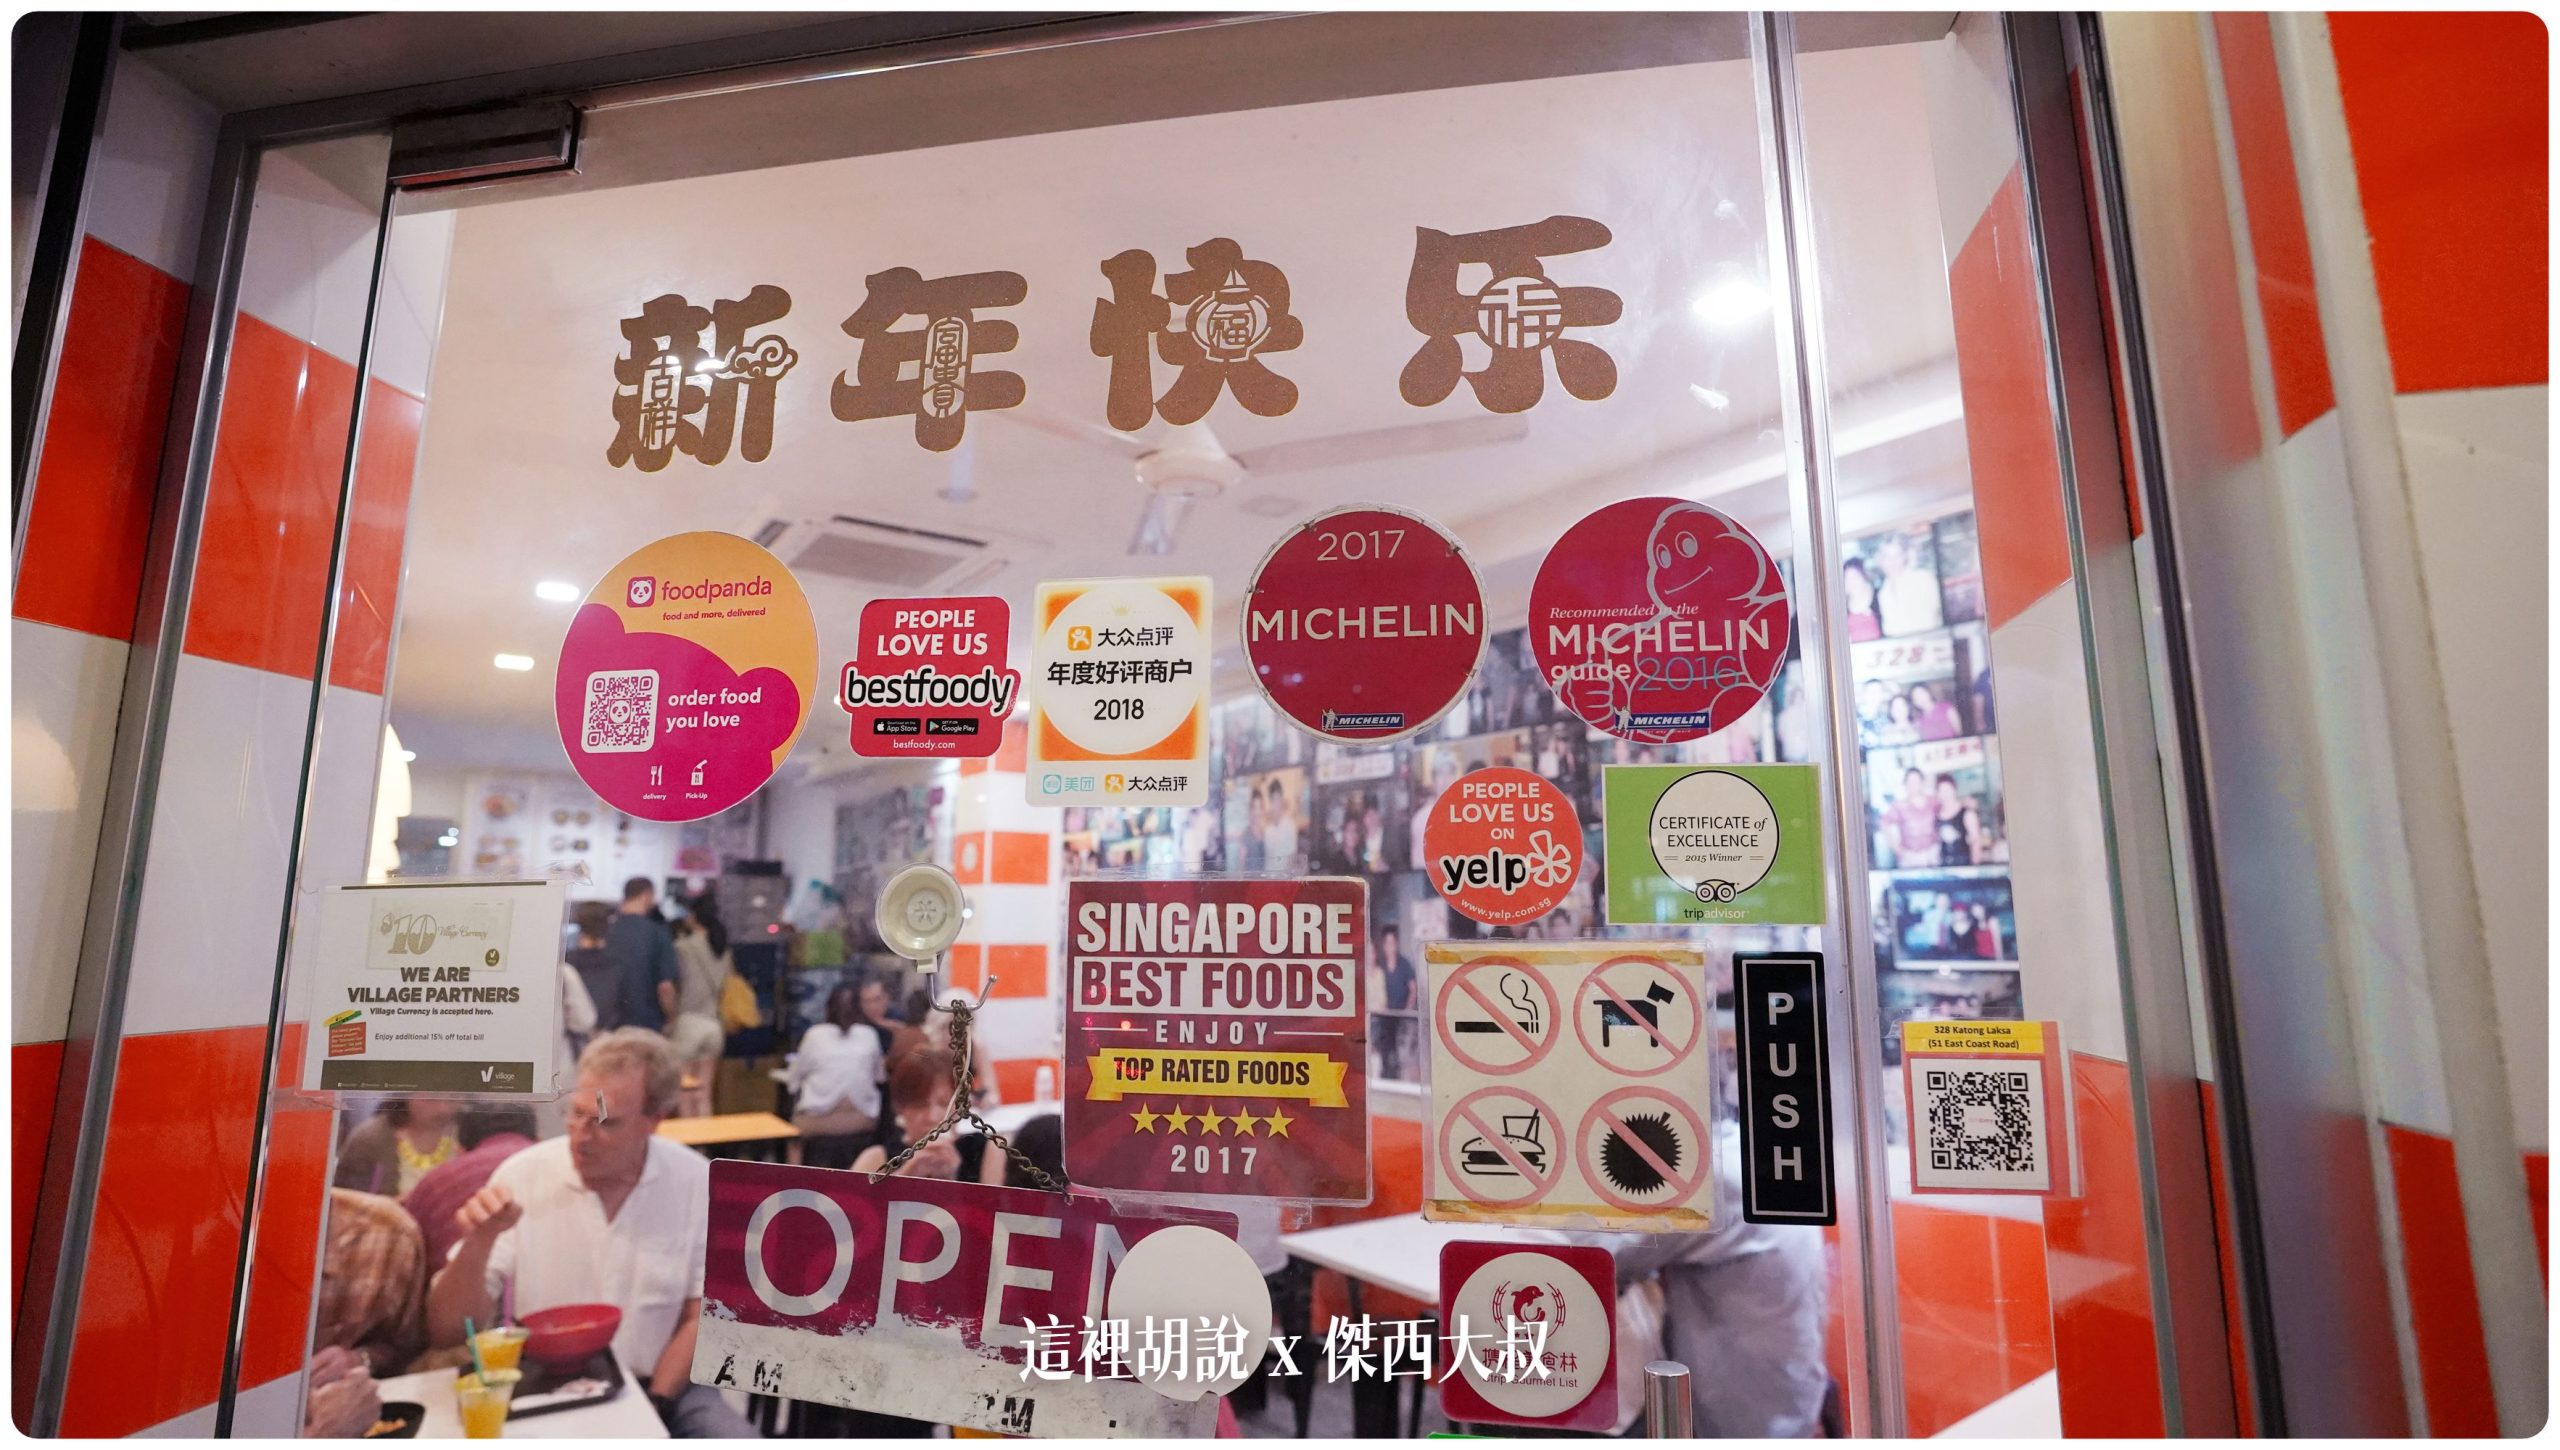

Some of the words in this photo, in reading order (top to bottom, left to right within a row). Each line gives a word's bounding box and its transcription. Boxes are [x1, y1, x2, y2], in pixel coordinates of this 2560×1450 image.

[1211, 306, 1252, 350] 福
[606, 215, 1624, 473] 新年快乐
[640, 350, 680, 448] 吉祥
[1317, 530, 1405, 561] 2017
[662, 576, 772, 603] foodpanda
[663, 611, 682, 621] food
[684, 610, 699, 620] and
[701, 611, 724, 619] more,
[727, 608, 766, 618] delivered
[895, 610, 975, 629] PEOPLE
[1550, 604, 1654, 619] Recommended
[1677, 603, 1699, 615] the
[1252, 603, 1475, 642] MICHELIN
[877, 633, 943, 656] LOVE
[953, 632, 988, 655] US
[1097, 627, 1174, 647] 大众点评
[1549, 619, 1770, 655] MICHELIN
[1047, 658, 1193, 686] 年度好评商户
[1551, 659, 1631, 684] guide
[1638, 655, 1739, 691] 2016
[668, 689, 716, 707] order
[720, 687, 762, 704] food
[848, 667, 1011, 713] bestfoody
[1094, 699, 1144, 721] 2018
[665, 714, 698, 733] you
[703, 712, 741, 728] love
[942, 725, 962, 733] Google
[1339, 715, 1400, 725] MICHELIN
[1634, 715, 1706, 725] MICHELIN
[893, 739, 955, 751] bestfoody.com
[1065, 777, 1094, 792] 美团
[1128, 776, 1187, 791] 大众点评
[1463, 782, 1540, 799] PEOPLE
[643, 793, 667, 801] delivery
[1450, 804, 1514, 823] LOVE
[1523, 803, 1554, 822] US
[1659, 815, 1750, 830] CERTIFICATE
[1754, 816, 1767, 832] of
[1490, 828, 1514, 840] ON
[1667, 834, 1758, 848] EXCELLENCE
[1685, 854, 1707, 864] 2015
[1709, 853, 1742, 863] Winner
[1444, 849, 1527, 891] yelp
[1461, 897, 1551, 921] www.yelp.com.sg
[1684, 907, 1746, 920] tripadvisor
[1077, 902, 1353, 955] SINGAPORE
[400, 967, 430, 982] WE
[433, 966, 470, 983] ARE
[347, 987, 422, 1003] VILLAGE
[425, 987, 520, 1003] PARTNERS
[1081, 961, 1187, 1007] BEST
[1202, 962, 1344, 1010] FOODS
[370, 1007, 395, 1016] Village
[397, 1008, 431, 1016] Currency
[432, 1007, 438, 1015] is
[440, 1007, 473, 1016] accepted
[475, 1007, 493, 1015] here.
[375, 1033, 393, 1041] Enjoy
[395, 1033, 429, 1041] additional
[431, 1033, 443, 1041] 15%
[445, 1033, 455, 1041] off
[456, 1033, 471, 1041] total
[473, 1033, 484, 1041] bill
[1155, 1020, 1268, 1045] ENJOY
[1934, 1026, 1950, 1034] 328
[1953, 1026, 1985, 1036] Katong
[1987, 1027, 2011, 1035] Laksa
[1945, 1040, 1963, 1048] East
[1966, 1040, 1990, 1048] Coast
[1992, 1040, 2019, 1049] Road)
[495, 1072, 515, 1081] village
[1113, 1057, 1154, 1081] TOP
[1161, 1059, 1229, 1084] RATED
[1237, 1061, 1310, 1085] FOODS
[1767, 992, 1802, 1180] PUSH
[1170, 1145, 1257, 1175] 2017
[1559, 1377, 1578, 1388] List
